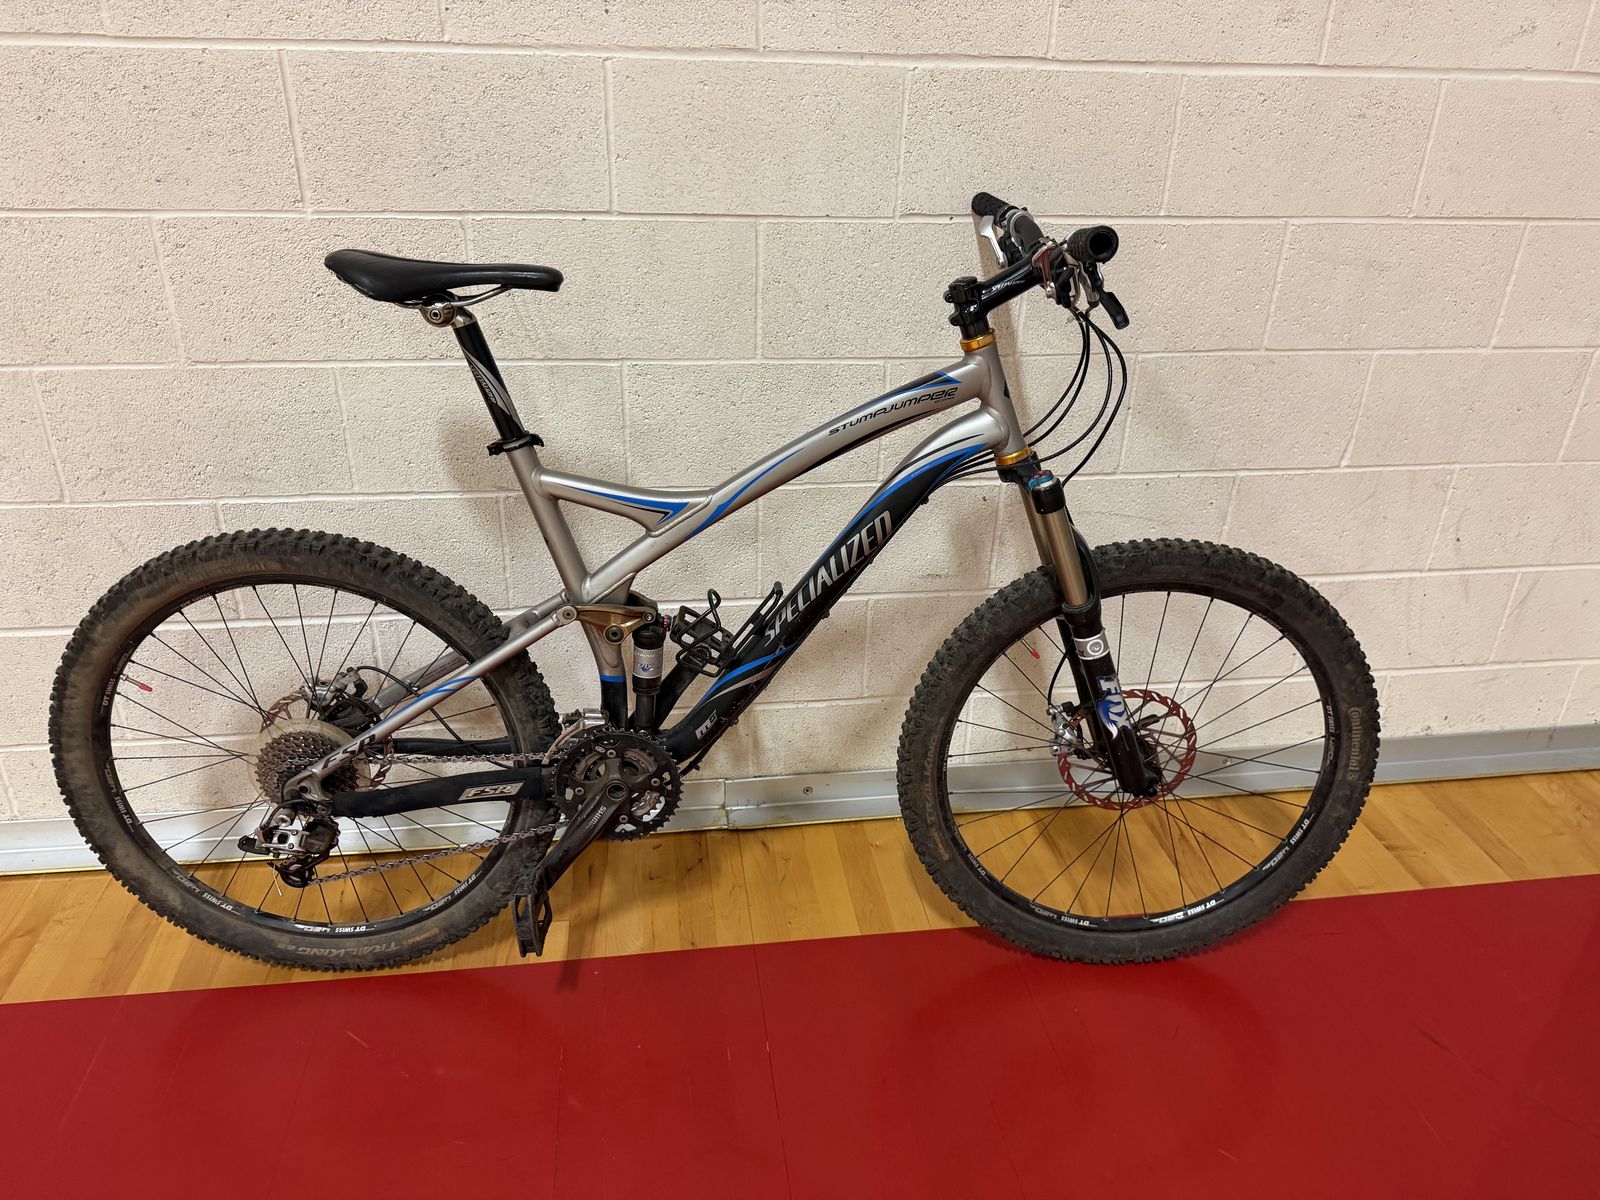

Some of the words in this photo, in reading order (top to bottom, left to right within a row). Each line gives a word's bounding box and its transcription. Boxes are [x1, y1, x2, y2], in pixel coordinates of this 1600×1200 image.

[828, 387, 958, 436] STUMPJUMPER
[764, 510, 893, 647] SPECIALIZED
[1099, 675, 1132, 730] FOX
[465, 785, 512, 799] FSR
[1187, 904, 1205, 916] SWISS
[1205, 900, 1216, 909] DT
